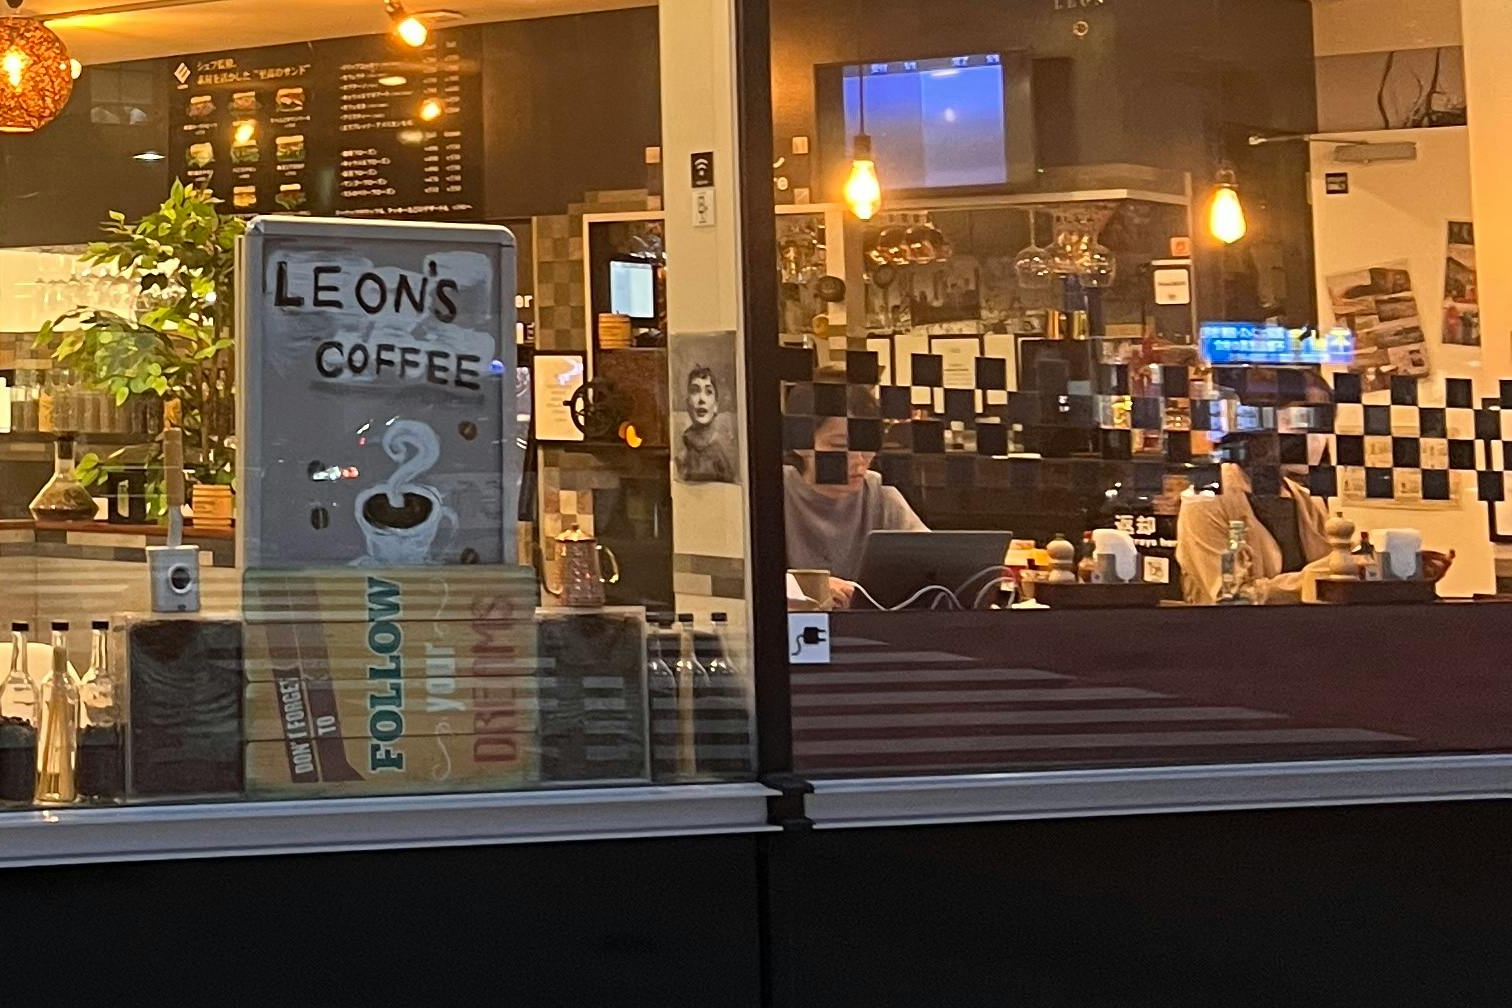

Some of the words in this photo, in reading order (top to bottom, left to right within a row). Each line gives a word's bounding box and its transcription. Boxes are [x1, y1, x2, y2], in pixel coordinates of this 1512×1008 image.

[274, 260, 459, 324] LEON'S
[315, 341, 481, 391] COFFEE
[366, 576, 405, 773] FOLLOW
[424, 642, 466, 713] your
[316, 714, 338, 736] TO
